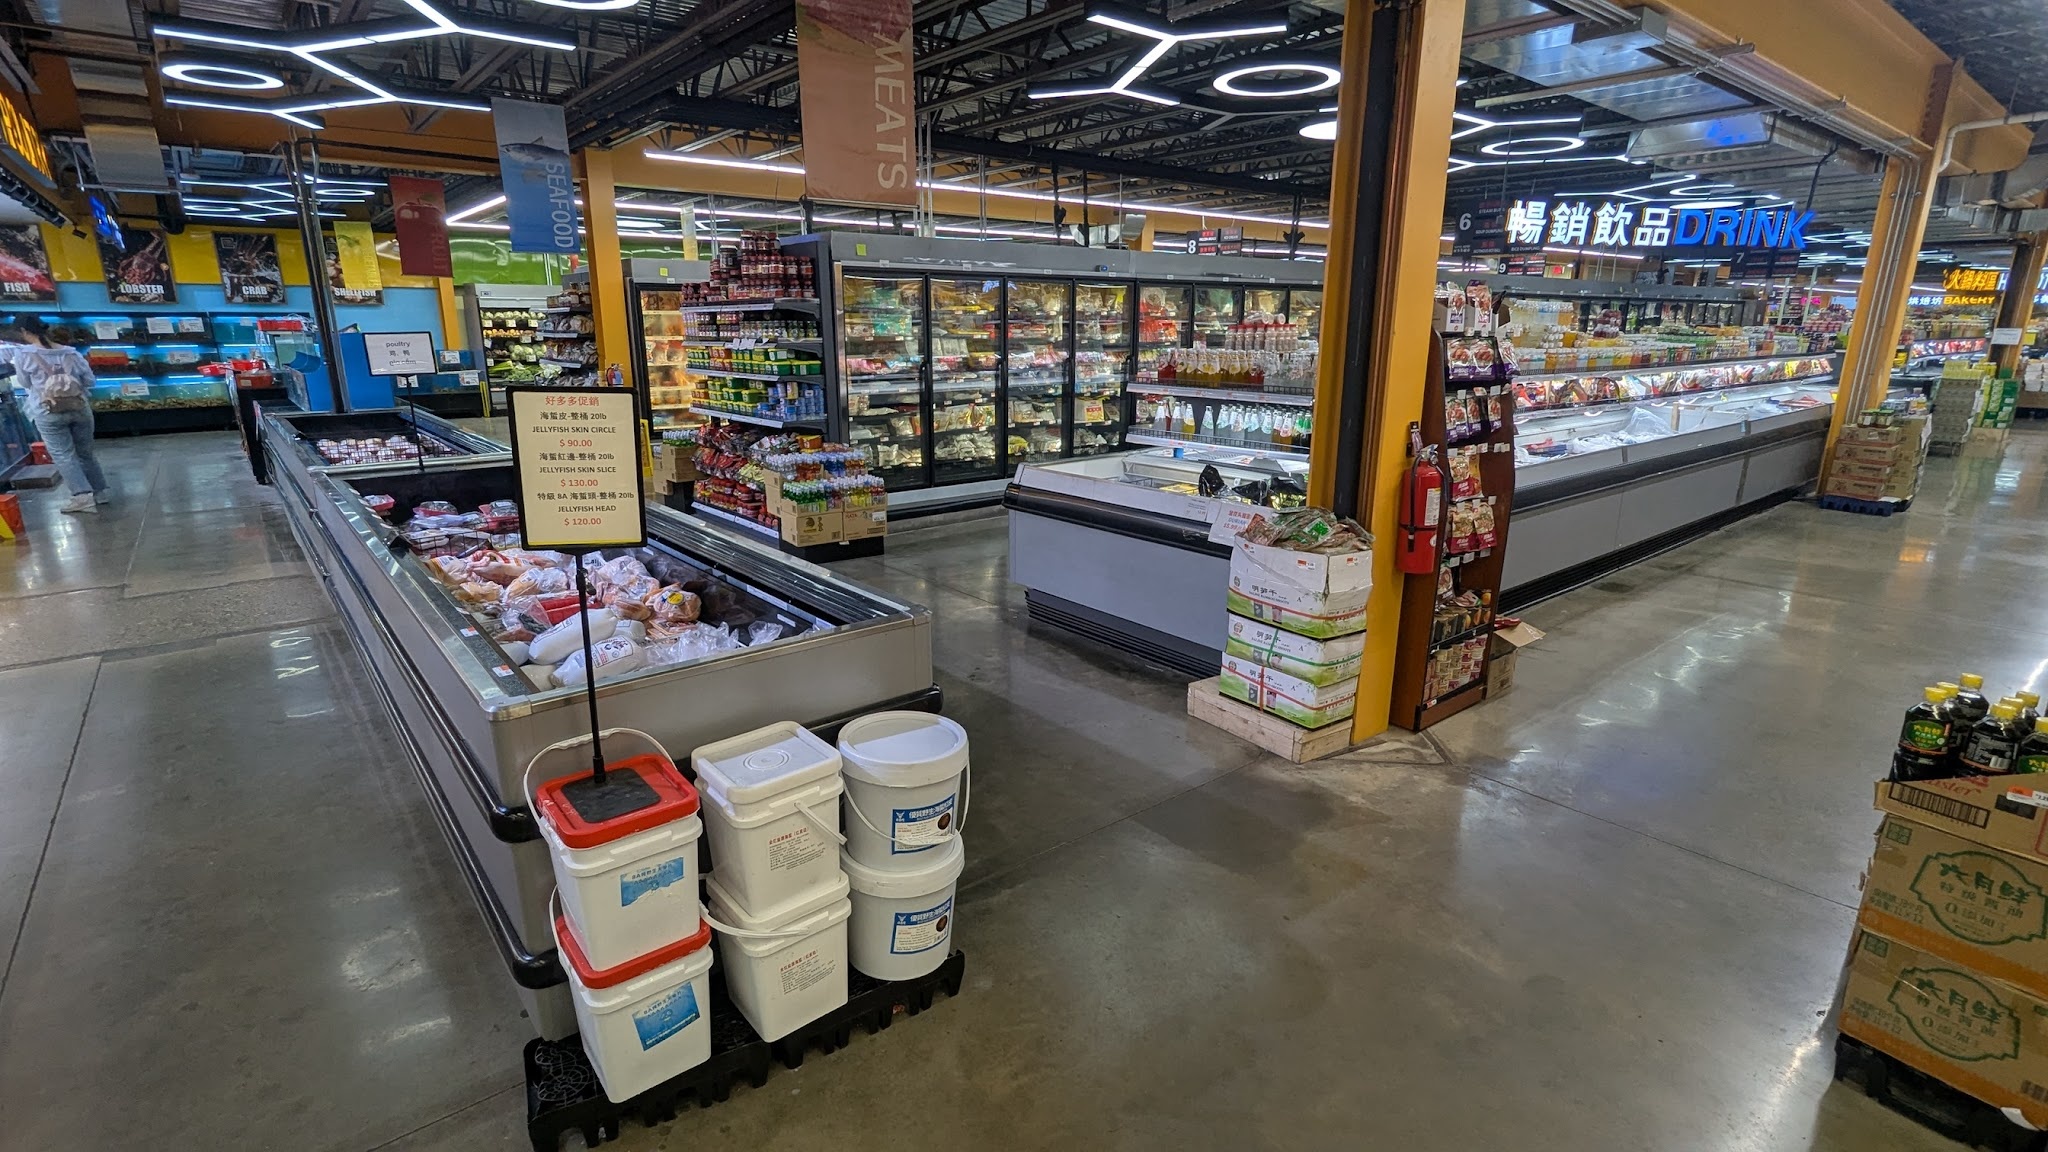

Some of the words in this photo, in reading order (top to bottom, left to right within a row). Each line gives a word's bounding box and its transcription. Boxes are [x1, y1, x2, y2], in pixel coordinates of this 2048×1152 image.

[873, 32, 908, 189] MEATS
[545, 160, 575, 248] SEAFOOD
[1460, 213, 1472, 230] 6
[1505, 200, 1671, 246] 暢銷飲品
[1674, 208, 1815, 248] DRINK
[1188, 240, 1196, 254] 8
[1736, 252, 1744, 263] 7
[1499, 263, 1506, 273] 9
[4, 282, 30, 292] FISH
[120, 284, 164, 294] LOBSTER
[242, 286, 268, 295] CRAB
[1908, 296, 1942, 305] 烘焙坊
[1944, 296, 1995, 305] BAKERY
[545, 396, 600, 406] 好多多促銷
[560, 439, 565, 447] $
[560, 479, 566, 487] $
[537, 492, 555, 500] 特級
[564, 518, 570, 526] $
